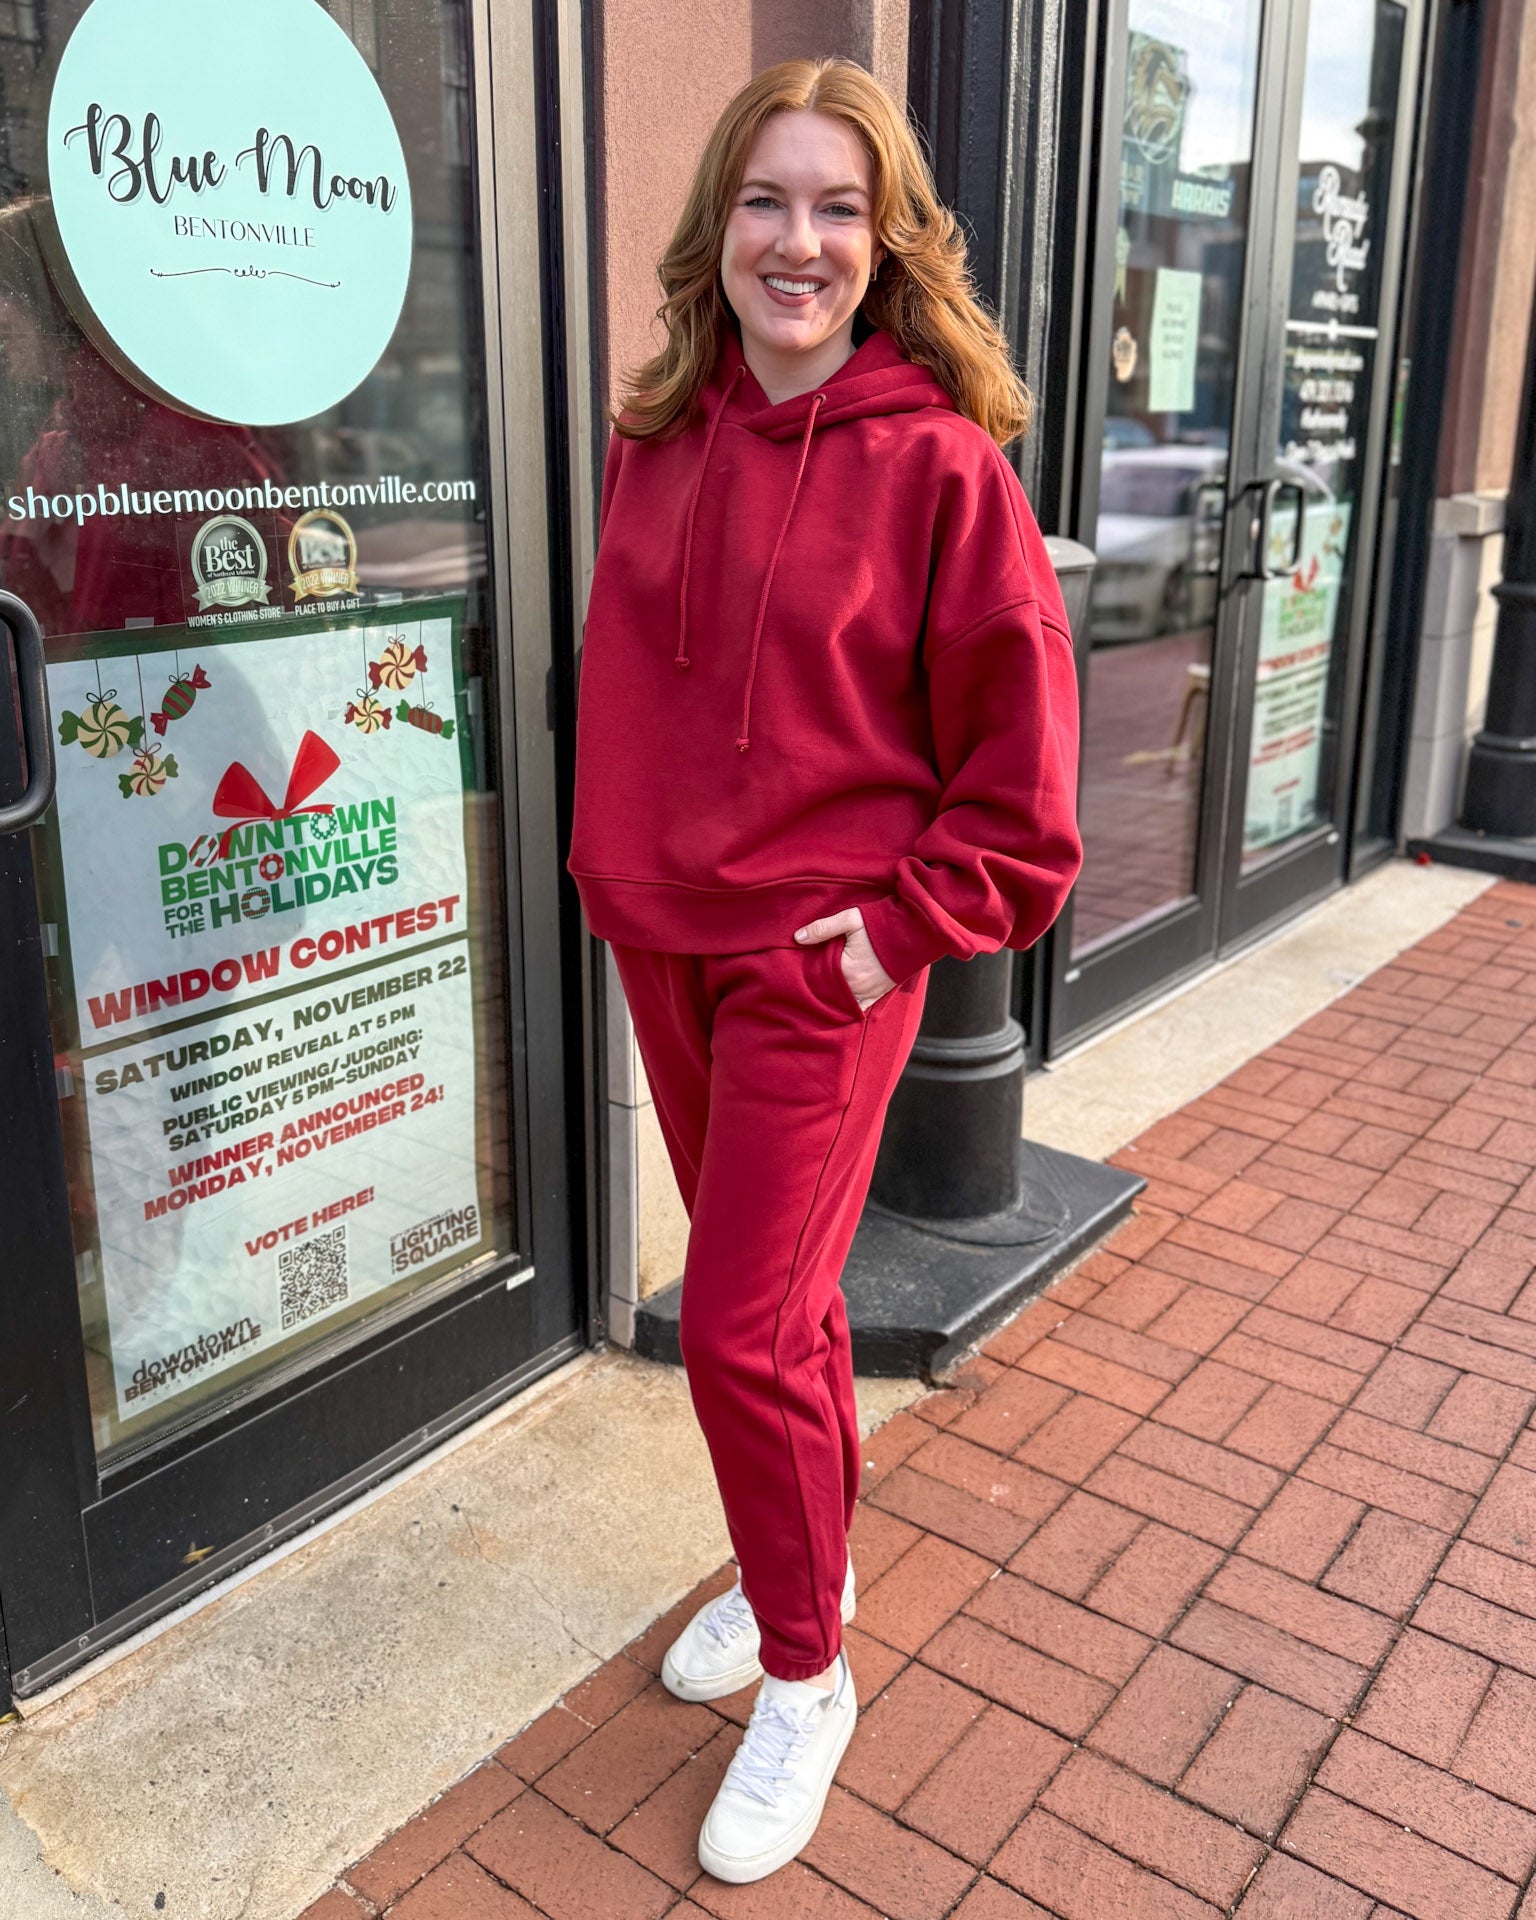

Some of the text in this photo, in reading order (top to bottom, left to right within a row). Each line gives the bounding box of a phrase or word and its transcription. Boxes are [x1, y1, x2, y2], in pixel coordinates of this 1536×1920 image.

[64, 103, 396, 211] Blue Moon
[174, 215, 316, 248] BENTONVILLE
[8, 476, 476, 526] shopbluemoonbentonville.com
[203, 544, 256, 573] Best
[220, 537, 238, 550] the
[205, 581, 258, 599] 2022 WINNER
[295, 598, 360, 616] PLACE TO BUY A GIFT
[301, 571, 349, 589] 2022 WINNER
[188, 606, 281, 628] WOMEN'S CLOTHING STORE
[158, 796, 396, 876] DOWNTOWN
[160, 827, 397, 906] BENTONVILLE
[164, 902, 203, 924] FOR
[166, 854, 399, 939] THE HOLIDAYS
[87, 895, 460, 1029] WINDOW CONTEST
[95, 955, 467, 1095] SATURDAY, NOVEMBER 22
[171, 1004, 416, 1102] WINDOW REVEAL AT 5 PM
[163, 1029, 423, 1135] PUBLIC VIEWING/JUDGING:
[144, 1084, 444, 1221] MONDAY, NOVEMBER 24!
[168, 1073, 424, 1187] WINNER ANNOUNCED
[169, 1095, 287, 1151] SATURDAY
[292, 1091, 303, 1105] 5
[245, 1186, 375, 1257] VOTE HERE!
[390, 1205, 477, 1257] LIGHTING
[395, 1220, 479, 1272] SQUARE
[124, 1324, 262, 1402] BENTONVILLE
[132, 1317, 252, 1385] downtown
